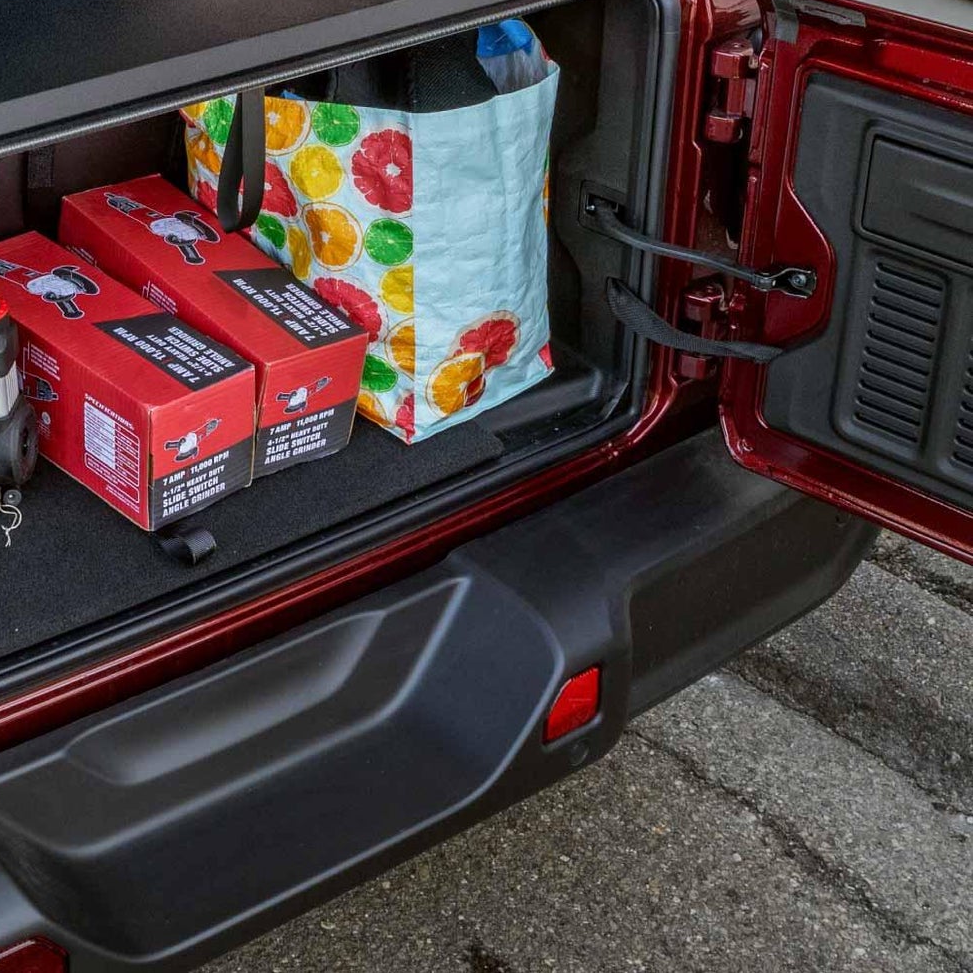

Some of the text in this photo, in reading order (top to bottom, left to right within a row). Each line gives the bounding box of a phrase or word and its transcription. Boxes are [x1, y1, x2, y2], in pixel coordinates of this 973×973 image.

[233, 278, 257, 295] RPM
[282, 292, 339, 334] SLIDE SWITCH
[285, 283, 350, 329] ANGLE GRINDER
[113, 327, 136, 342] RPM
[284, 319, 309, 335] AMP
[134, 340, 166, 361] 11,000
[164, 346, 189, 362] HEAVY
[164, 335, 224, 373] SLIDE SWITCH
[168, 327, 235, 367] ANGLE GRINDER
[167, 363, 196, 378] AMP
[275, 423, 291, 433] AMP
[319, 408, 334, 419] RPM
[265, 439, 326, 465] ANGLE GRINDER
[266, 432, 320, 455] SLIDE SWITCH
[169, 471, 185, 483] AMP
[191, 459, 212, 474] 11,000
[214, 451, 229, 463] RPM
[187, 474, 207, 487] HEAVY
[209, 465, 225, 477] DUTY
[163, 476, 218, 507] SLIDE SWITCH
[163, 483, 225, 517] ANGLE GRINDER
